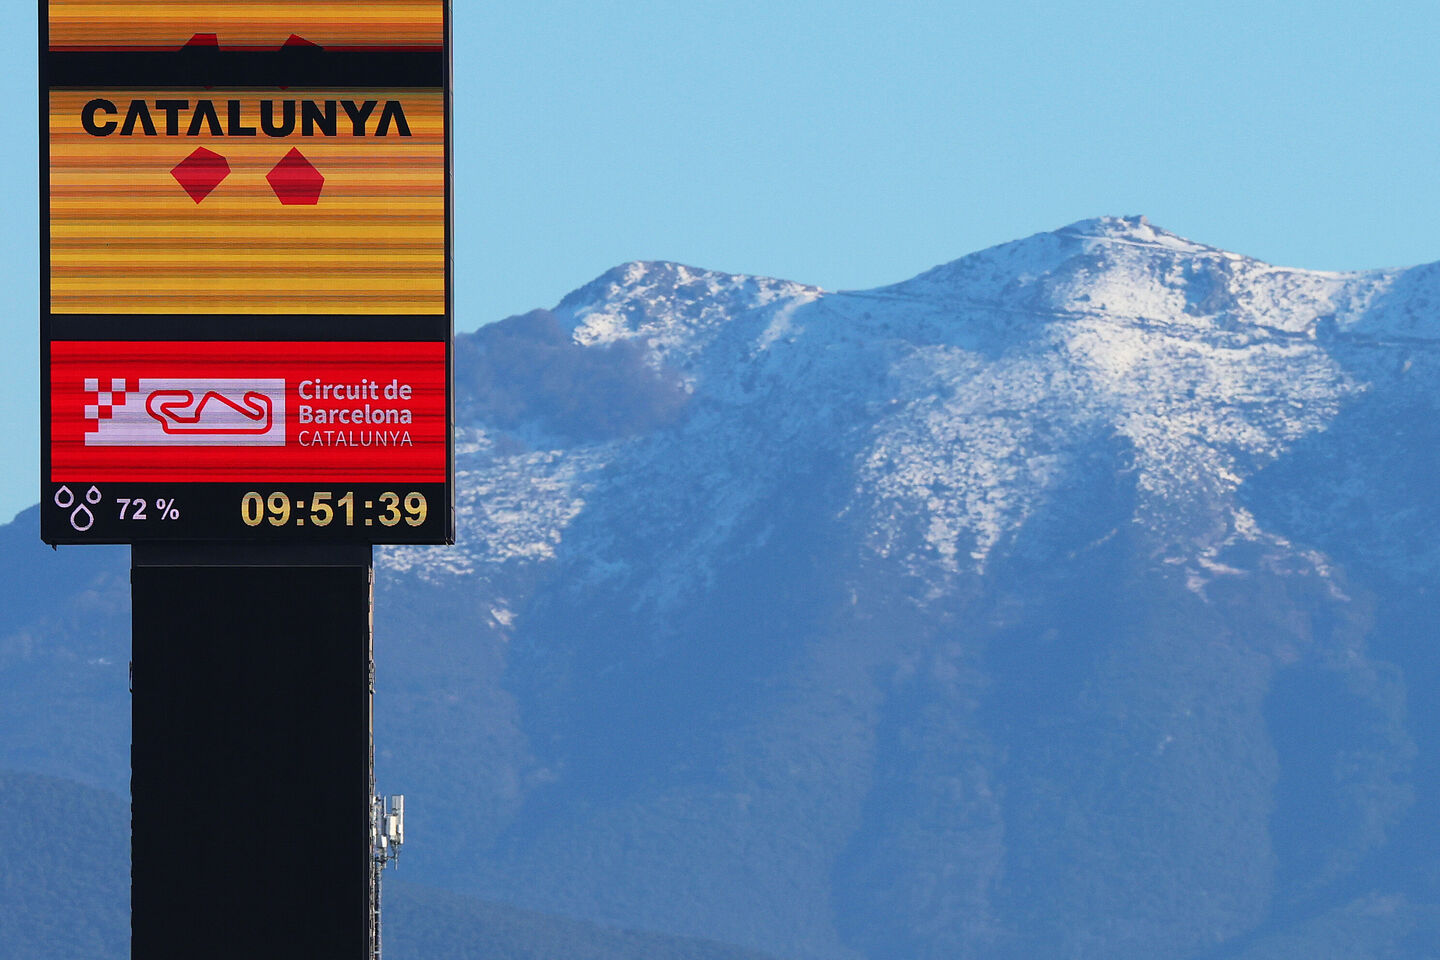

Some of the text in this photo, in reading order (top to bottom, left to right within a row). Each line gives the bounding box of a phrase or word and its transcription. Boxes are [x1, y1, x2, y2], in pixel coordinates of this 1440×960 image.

[80, 98, 413, 138] CATALUNYA
[298, 379, 412, 401] Circuit de
[298, 404, 412, 425] Barcelona
[298, 430, 413, 448] CATALUNYA
[116, 498, 180, 521] 72 %
[240, 491, 428, 527] 09:51:39
